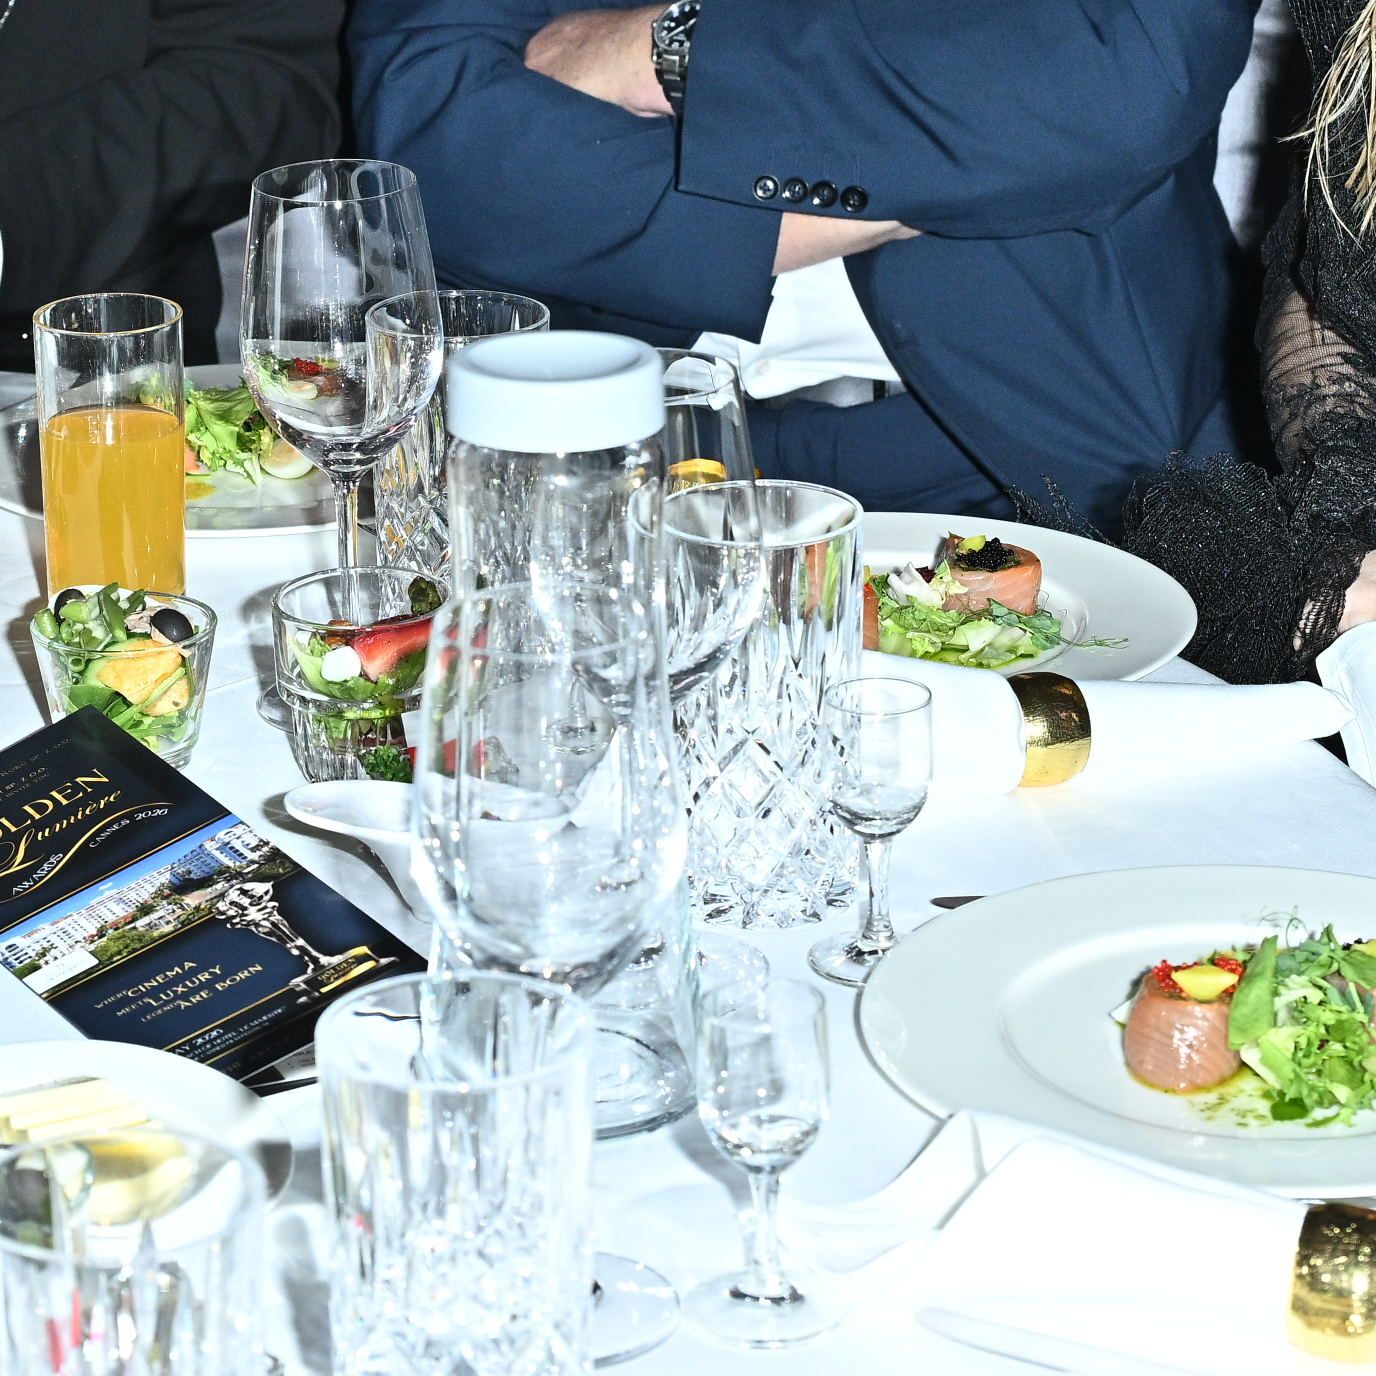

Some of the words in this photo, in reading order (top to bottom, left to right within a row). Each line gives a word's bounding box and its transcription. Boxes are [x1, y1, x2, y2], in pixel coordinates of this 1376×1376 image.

[12, 852, 64, 896] AWARDS
[89, 818, 130, 848] CANNES
[134, 808, 169, 822] 2026
[127, 961, 197, 998] CINEMA
[147, 964, 224, 1007] LUXURY
[176, 989, 214, 1010] ARE
[214, 963, 264, 992] BORN
